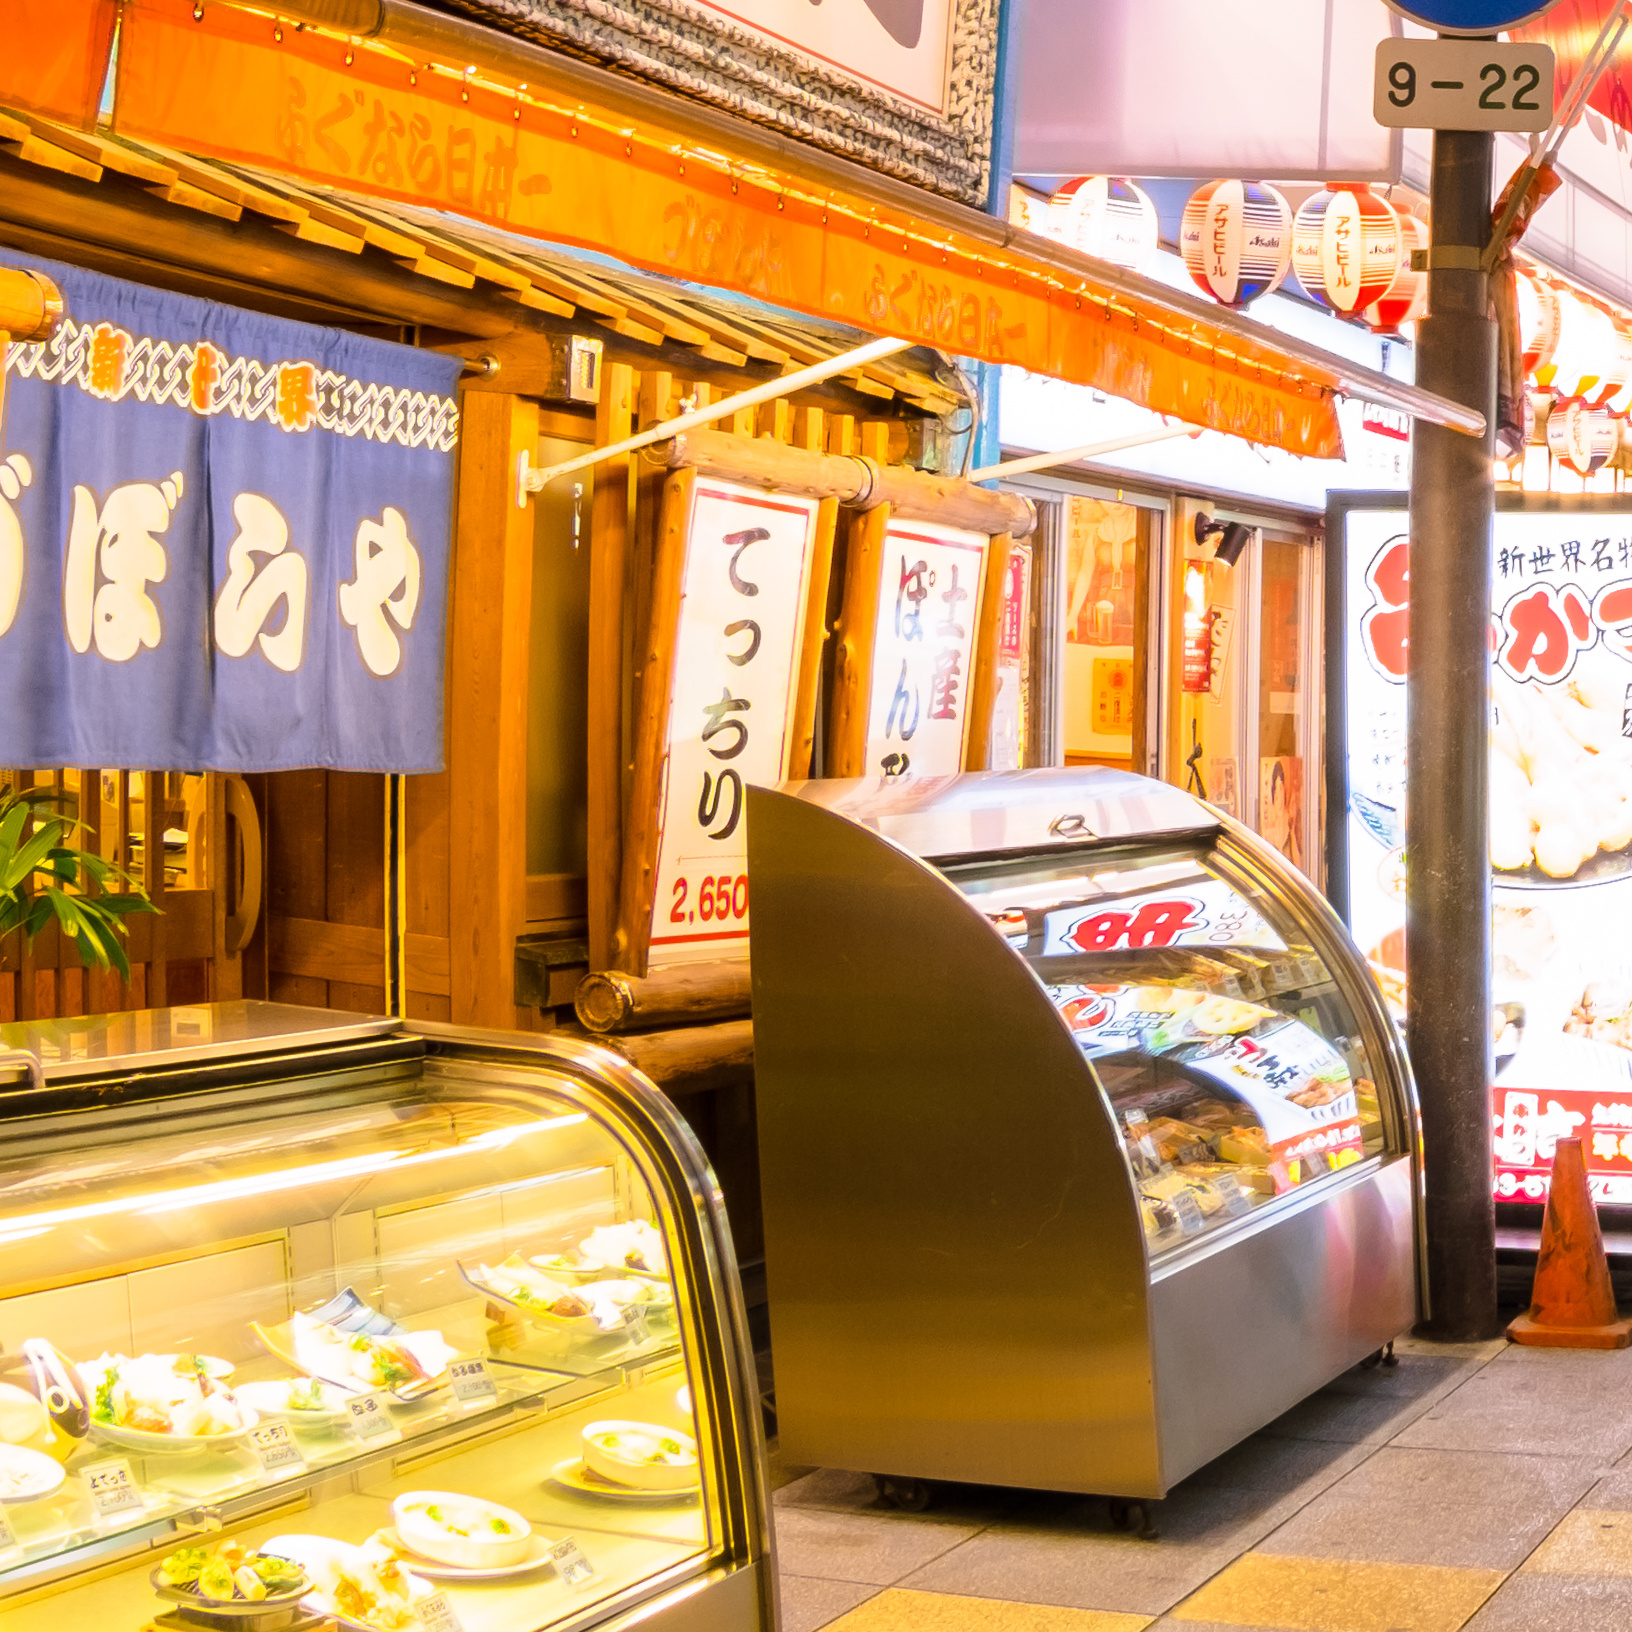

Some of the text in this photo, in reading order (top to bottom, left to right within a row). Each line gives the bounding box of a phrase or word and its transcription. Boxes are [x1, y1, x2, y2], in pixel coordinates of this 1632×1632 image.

[1210, 203, 1230, 278] アサヒビール
[1248, 233, 1281, 250] Asahi
[1335, 216, 1353, 289] アサヒビール
[90, 322, 320, 433] 新世界
[697, 526, 771, 841] てっちり
[928, 563, 968, 720] 土産
